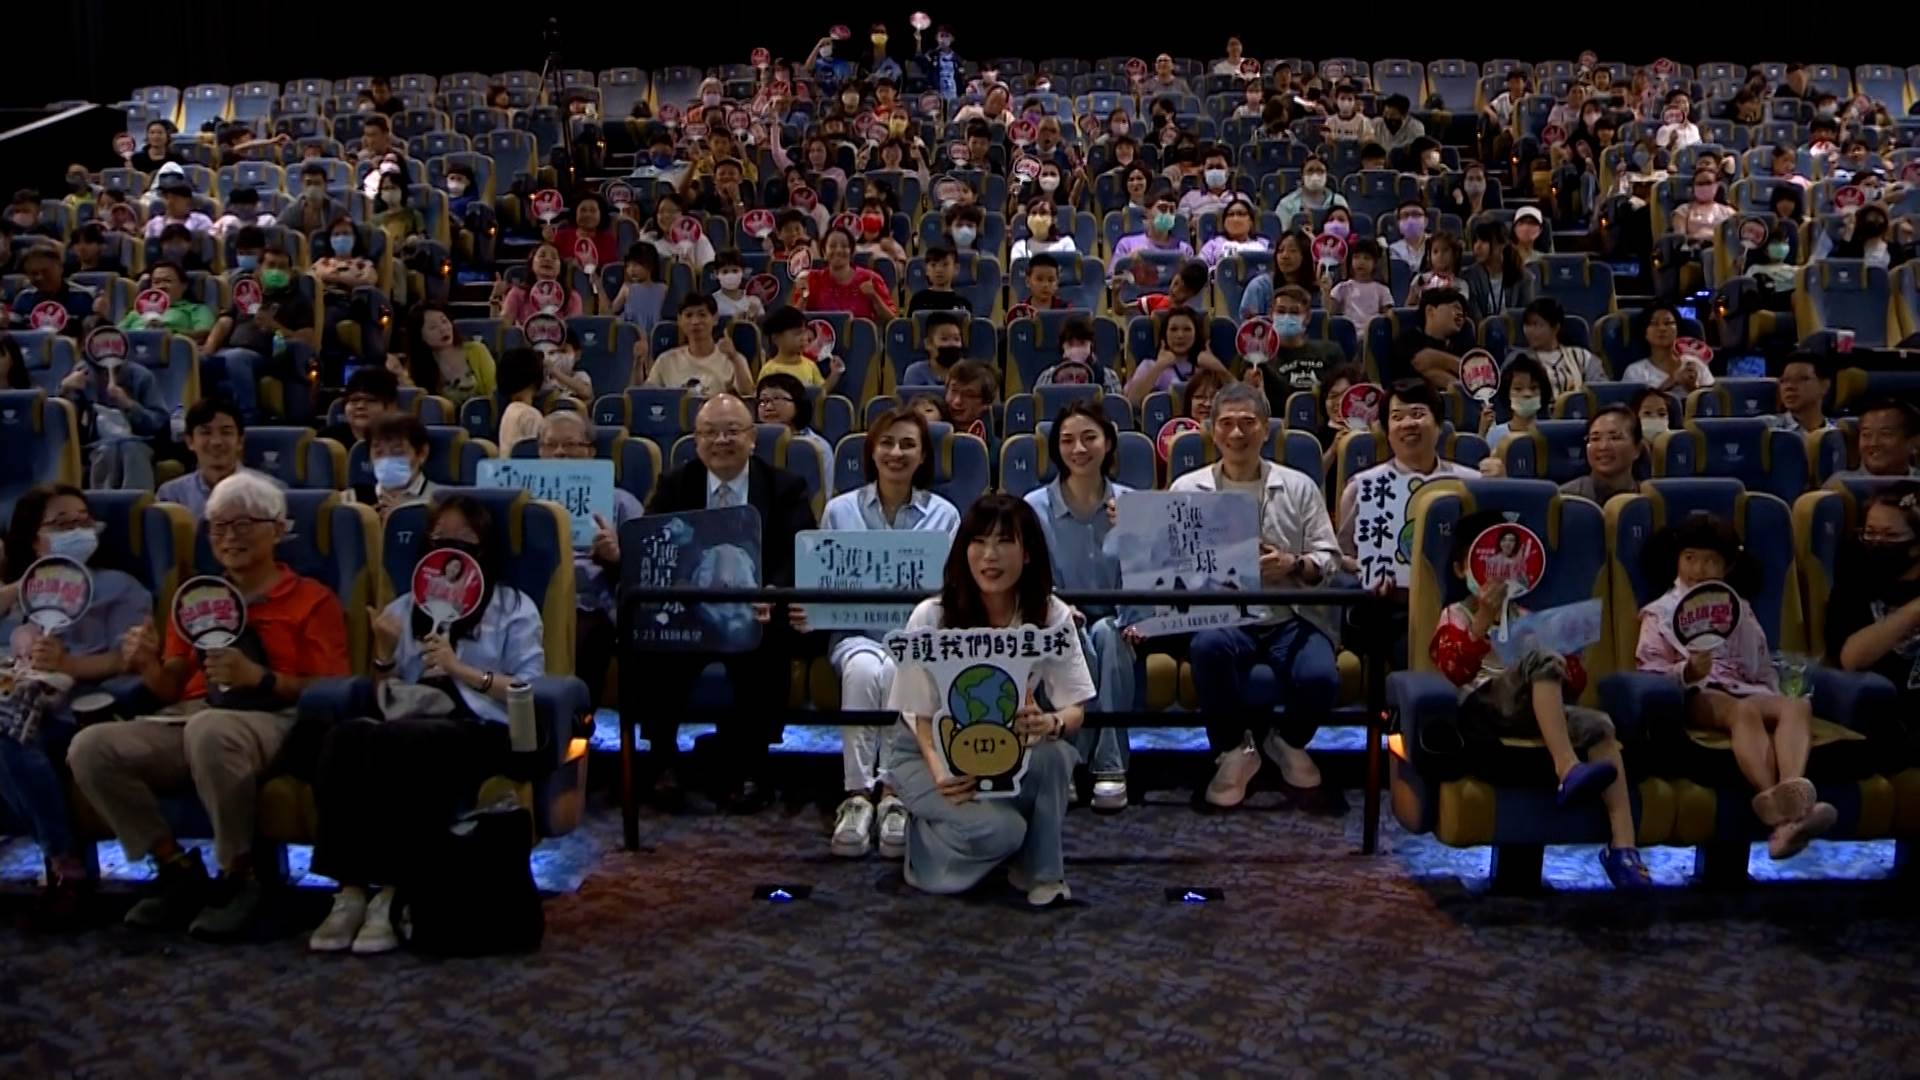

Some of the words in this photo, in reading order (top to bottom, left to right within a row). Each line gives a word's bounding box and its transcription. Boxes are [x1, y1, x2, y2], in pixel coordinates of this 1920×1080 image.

[1015, 459, 1026, 470] 14
[1358, 472, 1396, 586] 球球你
[1438, 522, 1451, 536] 12
[1632, 526, 1642, 538] 11
[397, 531, 413, 545] 17
[888, 627, 1070, 662] 守護我們的星球
